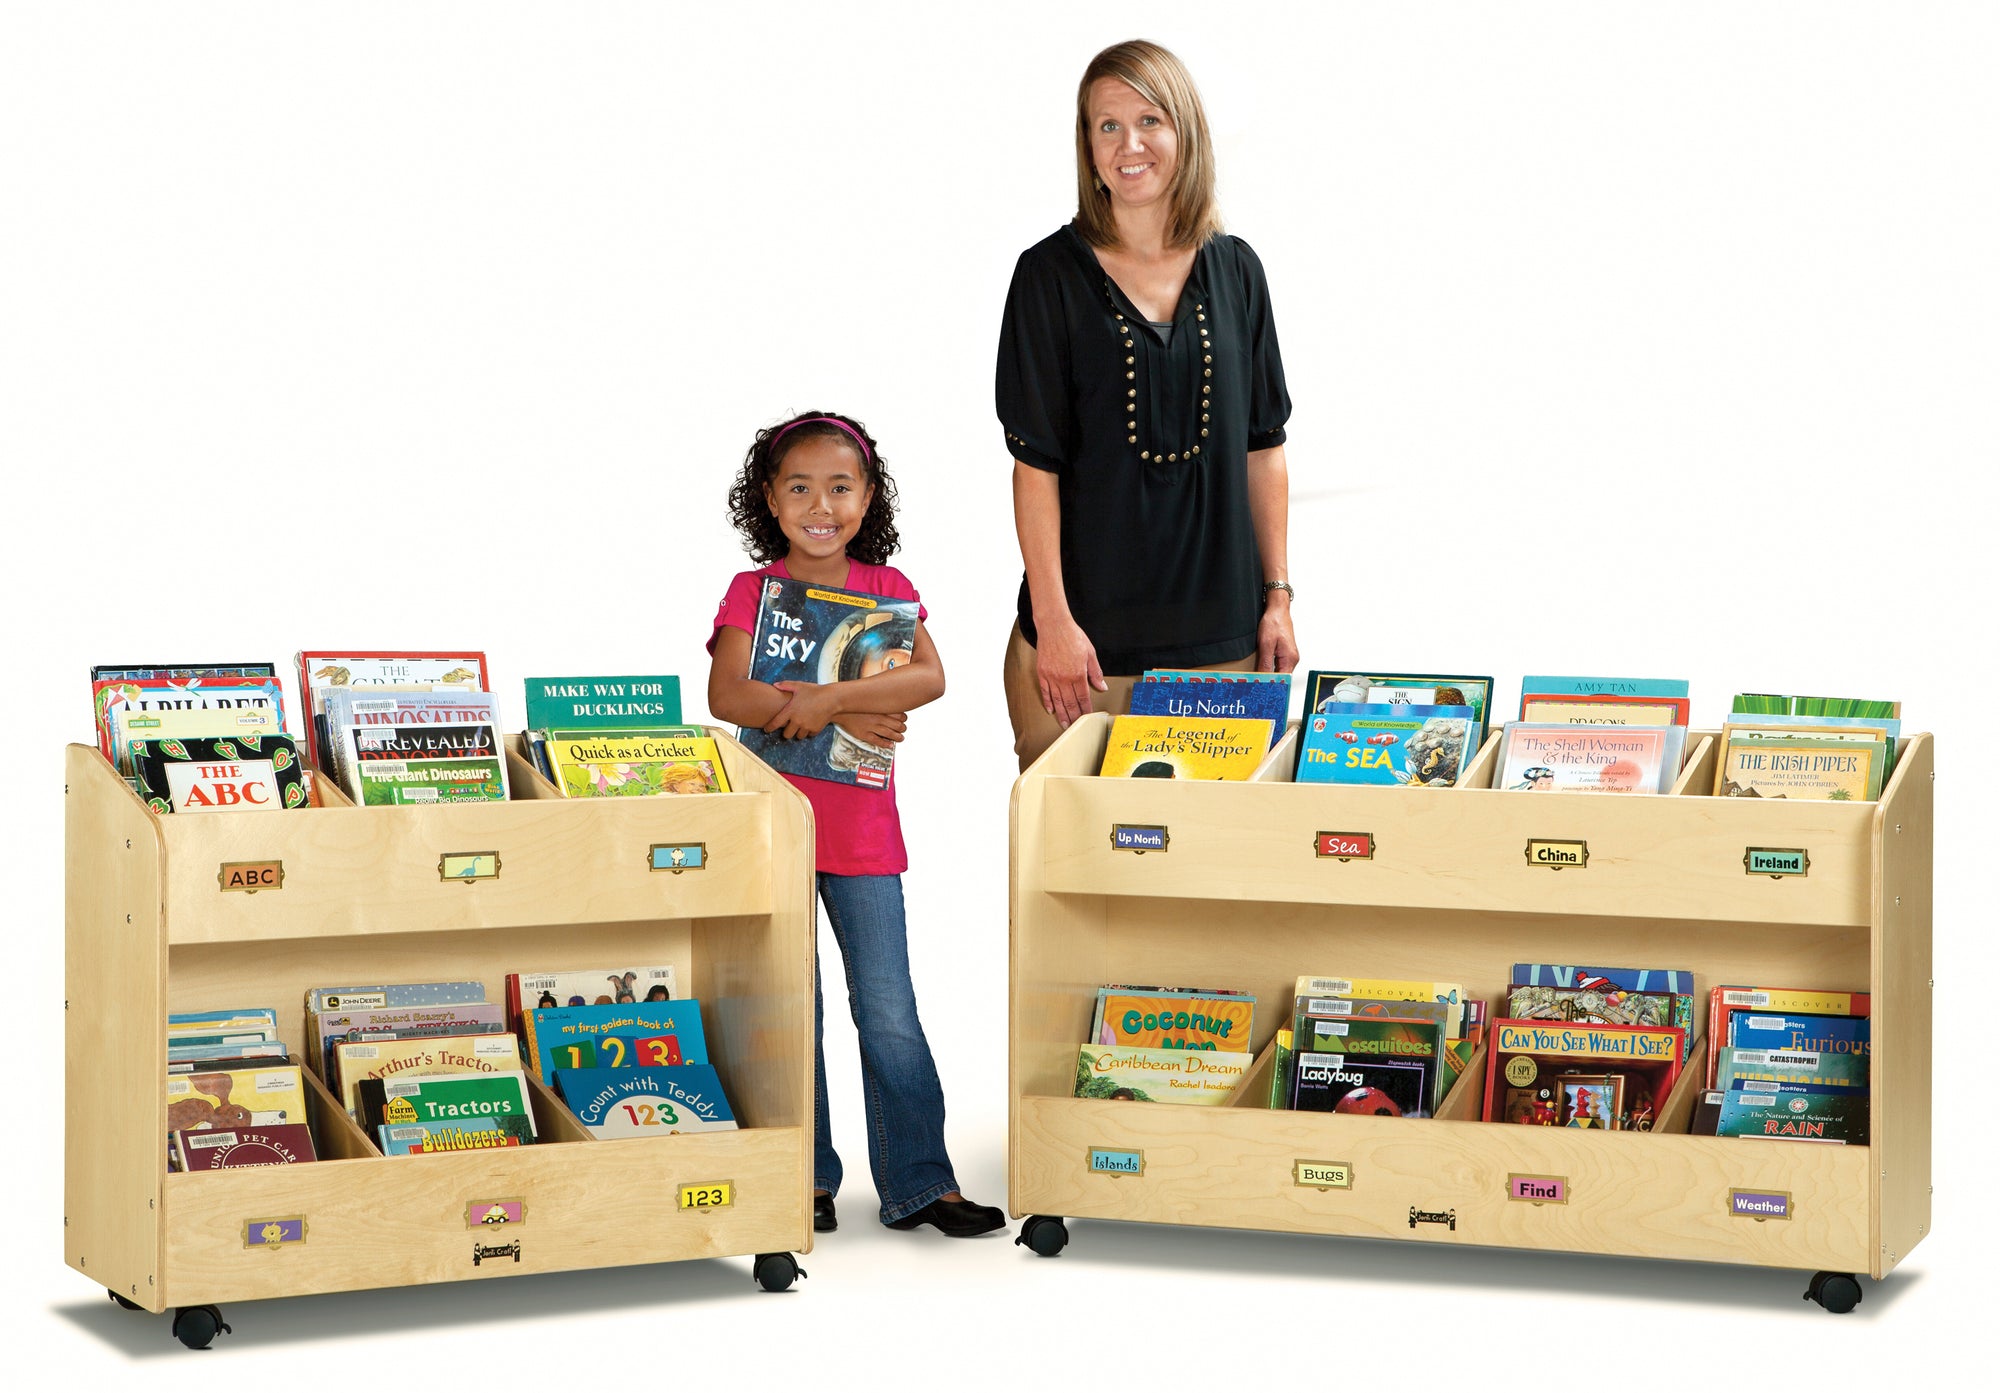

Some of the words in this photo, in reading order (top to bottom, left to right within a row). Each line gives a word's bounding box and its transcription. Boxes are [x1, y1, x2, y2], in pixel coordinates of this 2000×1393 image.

[813, 591, 830, 600] World
[772, 610, 804, 631] The
[765, 633, 816, 663] SKY
[380, 666, 410, 676] THE
[544, 684, 590, 698] MAKE
[594, 684, 626, 696] WAY
[631, 683, 664, 696] FOR
[1574, 682, 1604, 692] AMY
[1610, 684, 1637, 692] TAN
[573, 703, 664, 716] DUCKLINGS
[1168, 698, 1192, 716] Up
[1196, 698, 1246, 715] North
[386, 733, 490, 750] REVEALED
[1144, 730, 1163, 738] The
[1166, 726, 1226, 744] Legend
[1226, 732, 1240, 743] of
[570, 744, 615, 761] Quick
[617, 748, 632, 758] as
[634, 748, 642, 758] a
[643, 742, 696, 758] Cricket
[1120, 742, 1133, 750] the
[1133, 740, 1186, 757] Lady's
[1190, 742, 1253, 758] Slipper
[1524, 738, 1552, 751] The
[1554, 738, 1586, 752] Shell
[1588, 738, 1644, 752] Woman
[1307, 748, 1338, 764] The
[1345, 748, 1394, 770] SEA
[1542, 752, 1558, 765] &
[1561, 752, 1583, 764] the
[1586, 752, 1618, 767] King
[1740, 754, 1768, 770] THE
[1770, 754, 1809, 772] IRISH
[1813, 755, 1857, 772] PIPER
[196, 766, 242, 779] THE
[432, 768, 492, 782] Dinosaurs
[184, 782, 270, 807] ABC
[1118, 832, 1132, 844] Up
[1134, 834, 1161, 845] North
[1328, 838, 1360, 854] Sea
[1538, 848, 1576, 862] China
[1754, 856, 1799, 870] Ireland
[230, 868, 273, 886] ABC
[1560, 1000, 1588, 1022] The
[1773, 1000, 1842, 1009] ISCOVER
[370, 1014, 410, 1024] Richard
[413, 1012, 456, 1022] Scarry's
[562, 1025, 576, 1035] my
[578, 1022, 598, 1034] first
[600, 1018, 634, 1033] golden
[636, 1016, 661, 1030] book
[663, 1018, 675, 1030] of
[1122, 1010, 1234, 1038] Coconut
[1314, 1033, 1432, 1055] Mosquitoes
[1500, 1028, 1531, 1050] CAN
[1532, 1030, 1560, 1050] YOU
[1561, 1031, 1586, 1052] SEE
[1588, 1032, 1628, 1054] WHAT
[1630, 1034, 1636, 1054] I
[1638, 1034, 1674, 1056] SEE?
[567, 1046, 581, 1068] 1
[601, 1037, 631, 1068] 2
[1769, 1054, 1817, 1065] CATASTROPHE!
[368, 1052, 433, 1080] Arthur's
[1094, 1053, 1181, 1074] Caribbean
[1184, 1056, 1243, 1075] Dream
[1517, 1065, 1530, 1076] SPY
[1301, 1066, 1364, 1086] Ladybug
[1169, 1079, 1200, 1089] Rachel
[1203, 1080, 1236, 1091] Isadora
[1780, 1084, 1808, 1093] isasters
[580, 1085, 618, 1123] Count
[619, 1076, 659, 1092] with
[668, 1081, 718, 1120] Teddy
[389, 1106, 414, 1114] Farm
[425, 1100, 512, 1118] Tractors
[622, 1103, 680, 1126] 123
[1766, 1112, 1790, 1120] Nature
[1807, 1114, 1834, 1122] Science
[1764, 1120, 1824, 1136] RAIN
[422, 1128, 508, 1152] Bulldozers
[211, 1144, 235, 1170] UNIO
[242, 1134, 269, 1144] PET
[1095, 1156, 1138, 1171] islands
[1304, 1168, 1344, 1182] Bugs
[687, 1189, 722, 1207] 123
[1520, 1182, 1556, 1198] Find
[1736, 1198, 1786, 1213] Weather
